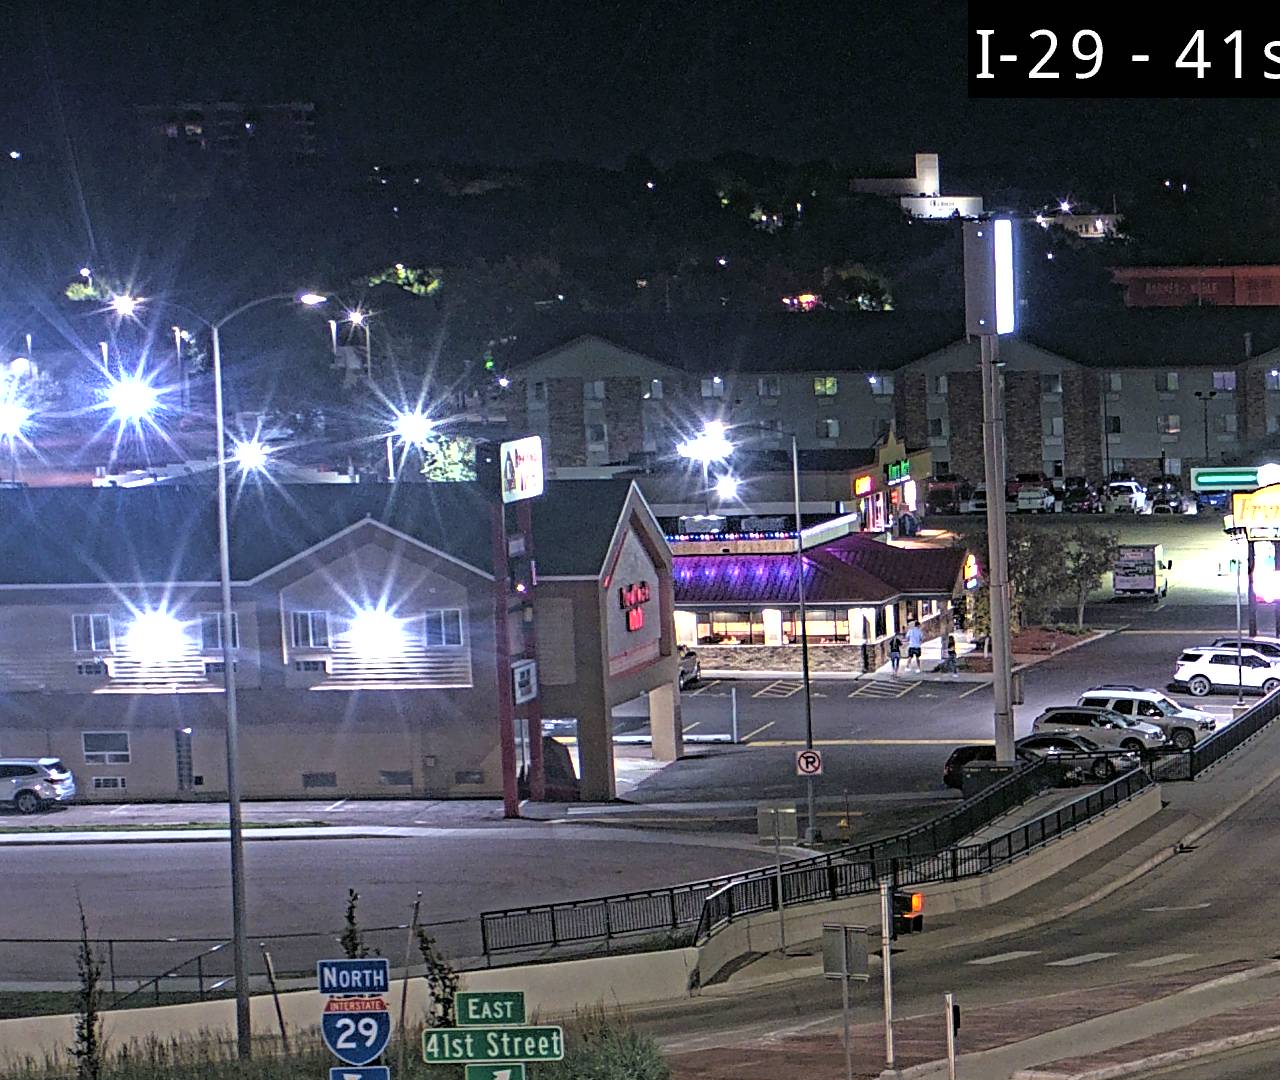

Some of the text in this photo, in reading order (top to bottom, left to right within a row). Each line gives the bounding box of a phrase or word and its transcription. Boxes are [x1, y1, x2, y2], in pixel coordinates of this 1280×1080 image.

[323, 965, 385, 989] NORTH
[329, 999, 383, 1010] INTERSTATE
[468, 997, 513, 1019] EAST
[335, 1016, 378, 1049] 29
[426, 1031, 561, 1057] 41st Street
